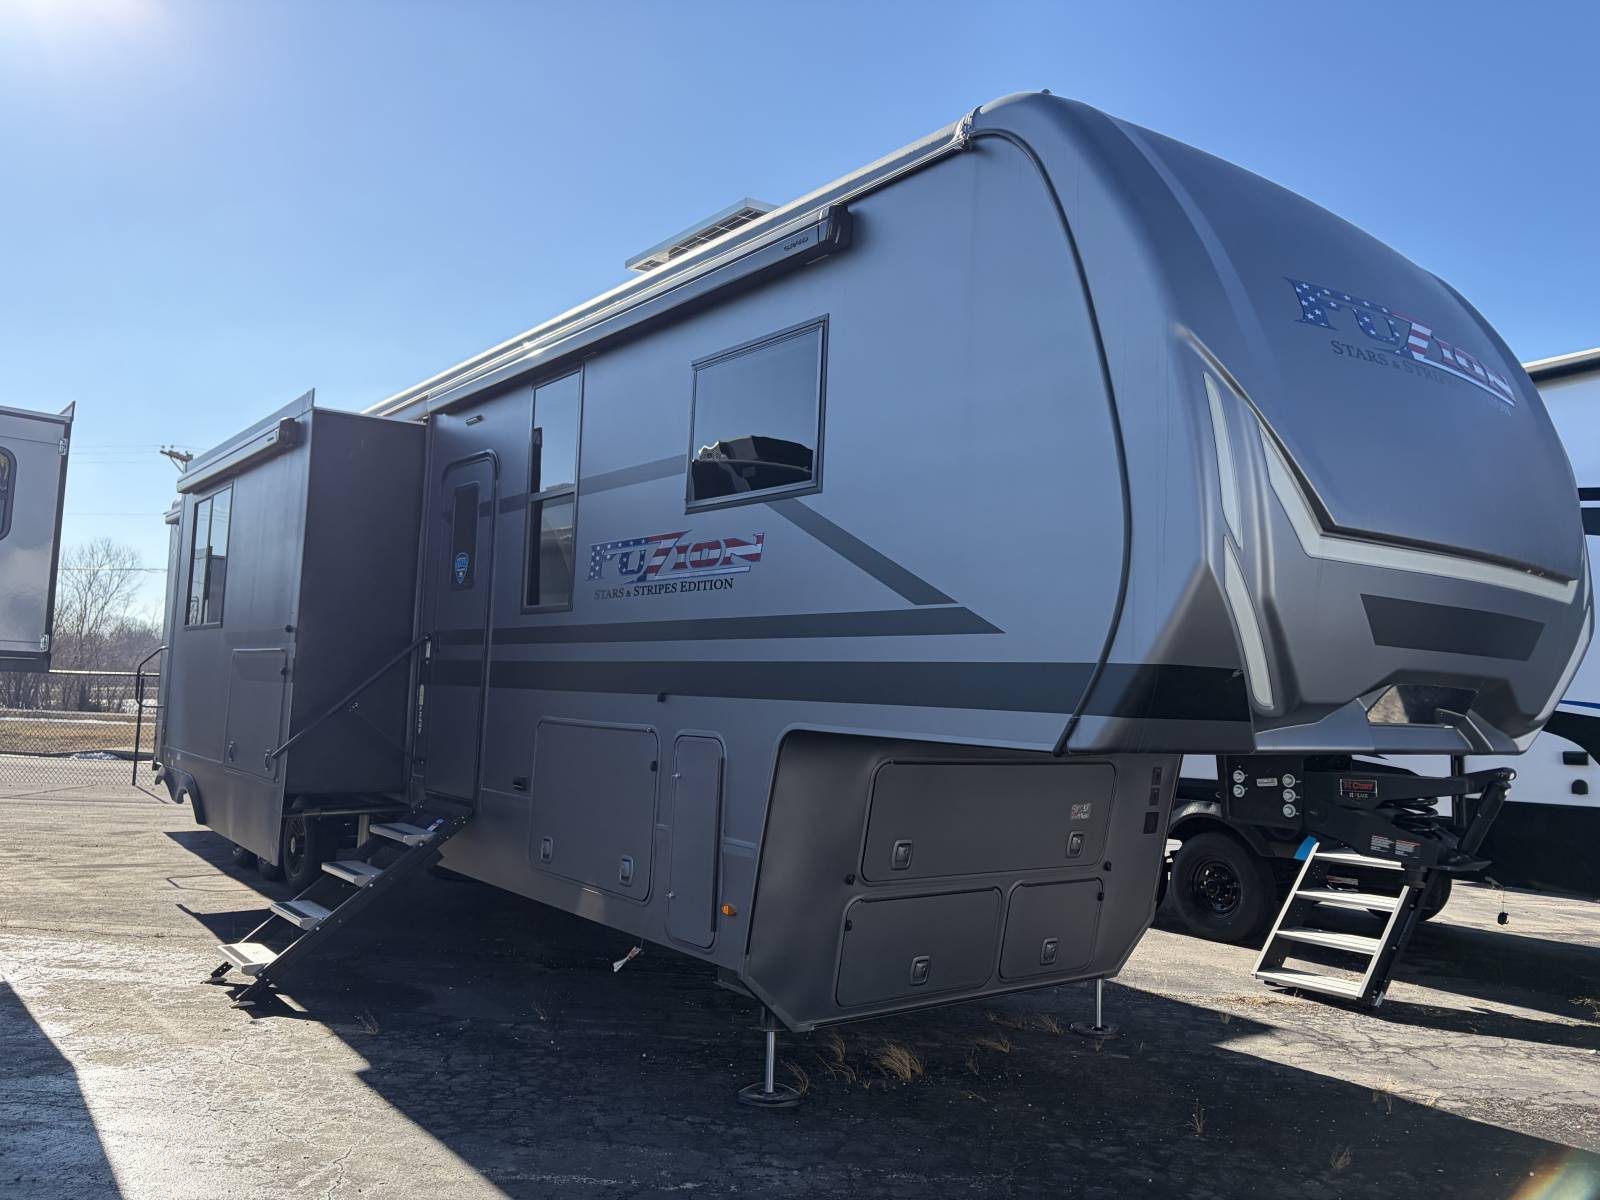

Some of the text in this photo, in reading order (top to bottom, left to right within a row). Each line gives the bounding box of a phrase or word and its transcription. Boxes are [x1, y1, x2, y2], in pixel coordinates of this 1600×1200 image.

[1281, 275, 1516, 407] FUZION
[1330, 340, 1387, 366] STARS
[584, 529, 765, 584] FUZION
[593, 587, 625, 600] STARS
[633, 582, 677, 597] STRIPES
[680, 577, 734, 593] EDITION
